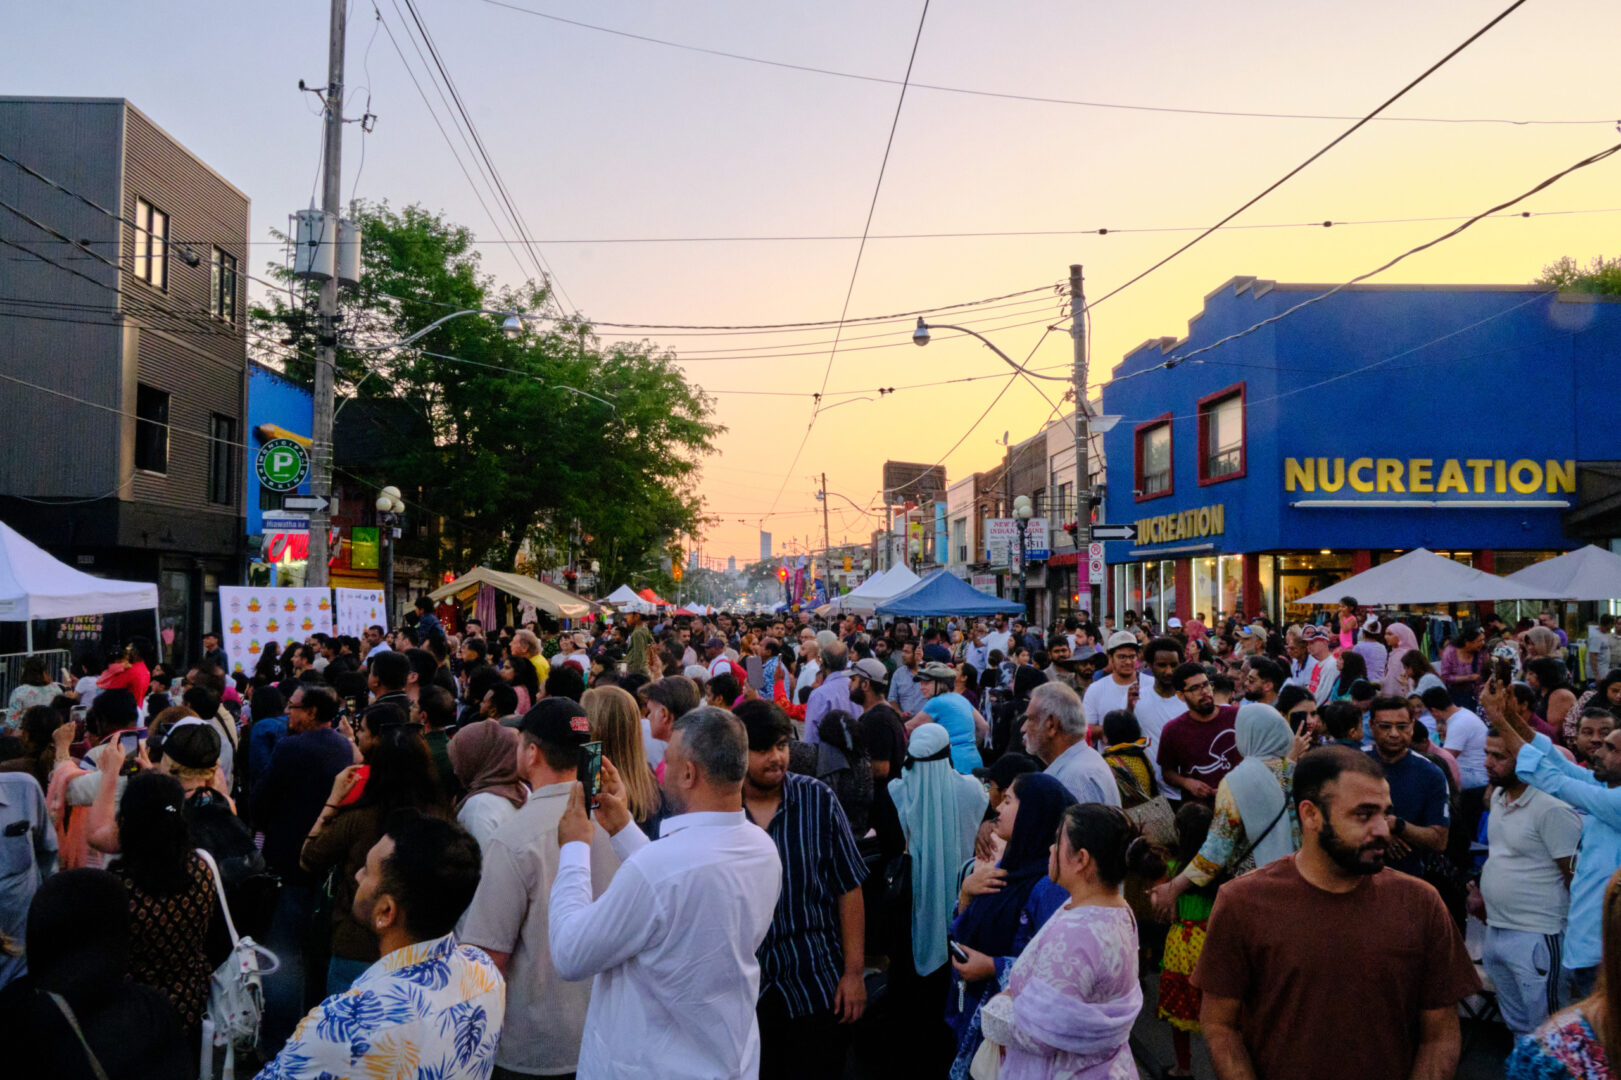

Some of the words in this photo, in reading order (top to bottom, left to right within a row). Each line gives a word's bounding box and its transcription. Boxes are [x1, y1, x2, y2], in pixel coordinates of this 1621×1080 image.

[259, 440, 306, 464] MUNICIPAL
[274, 452, 293, 472] P
[259, 468, 305, 489] PARKING
[1285, 457, 1577, 494] NUCREATION
[61, 623, 102, 631] SUMMER
